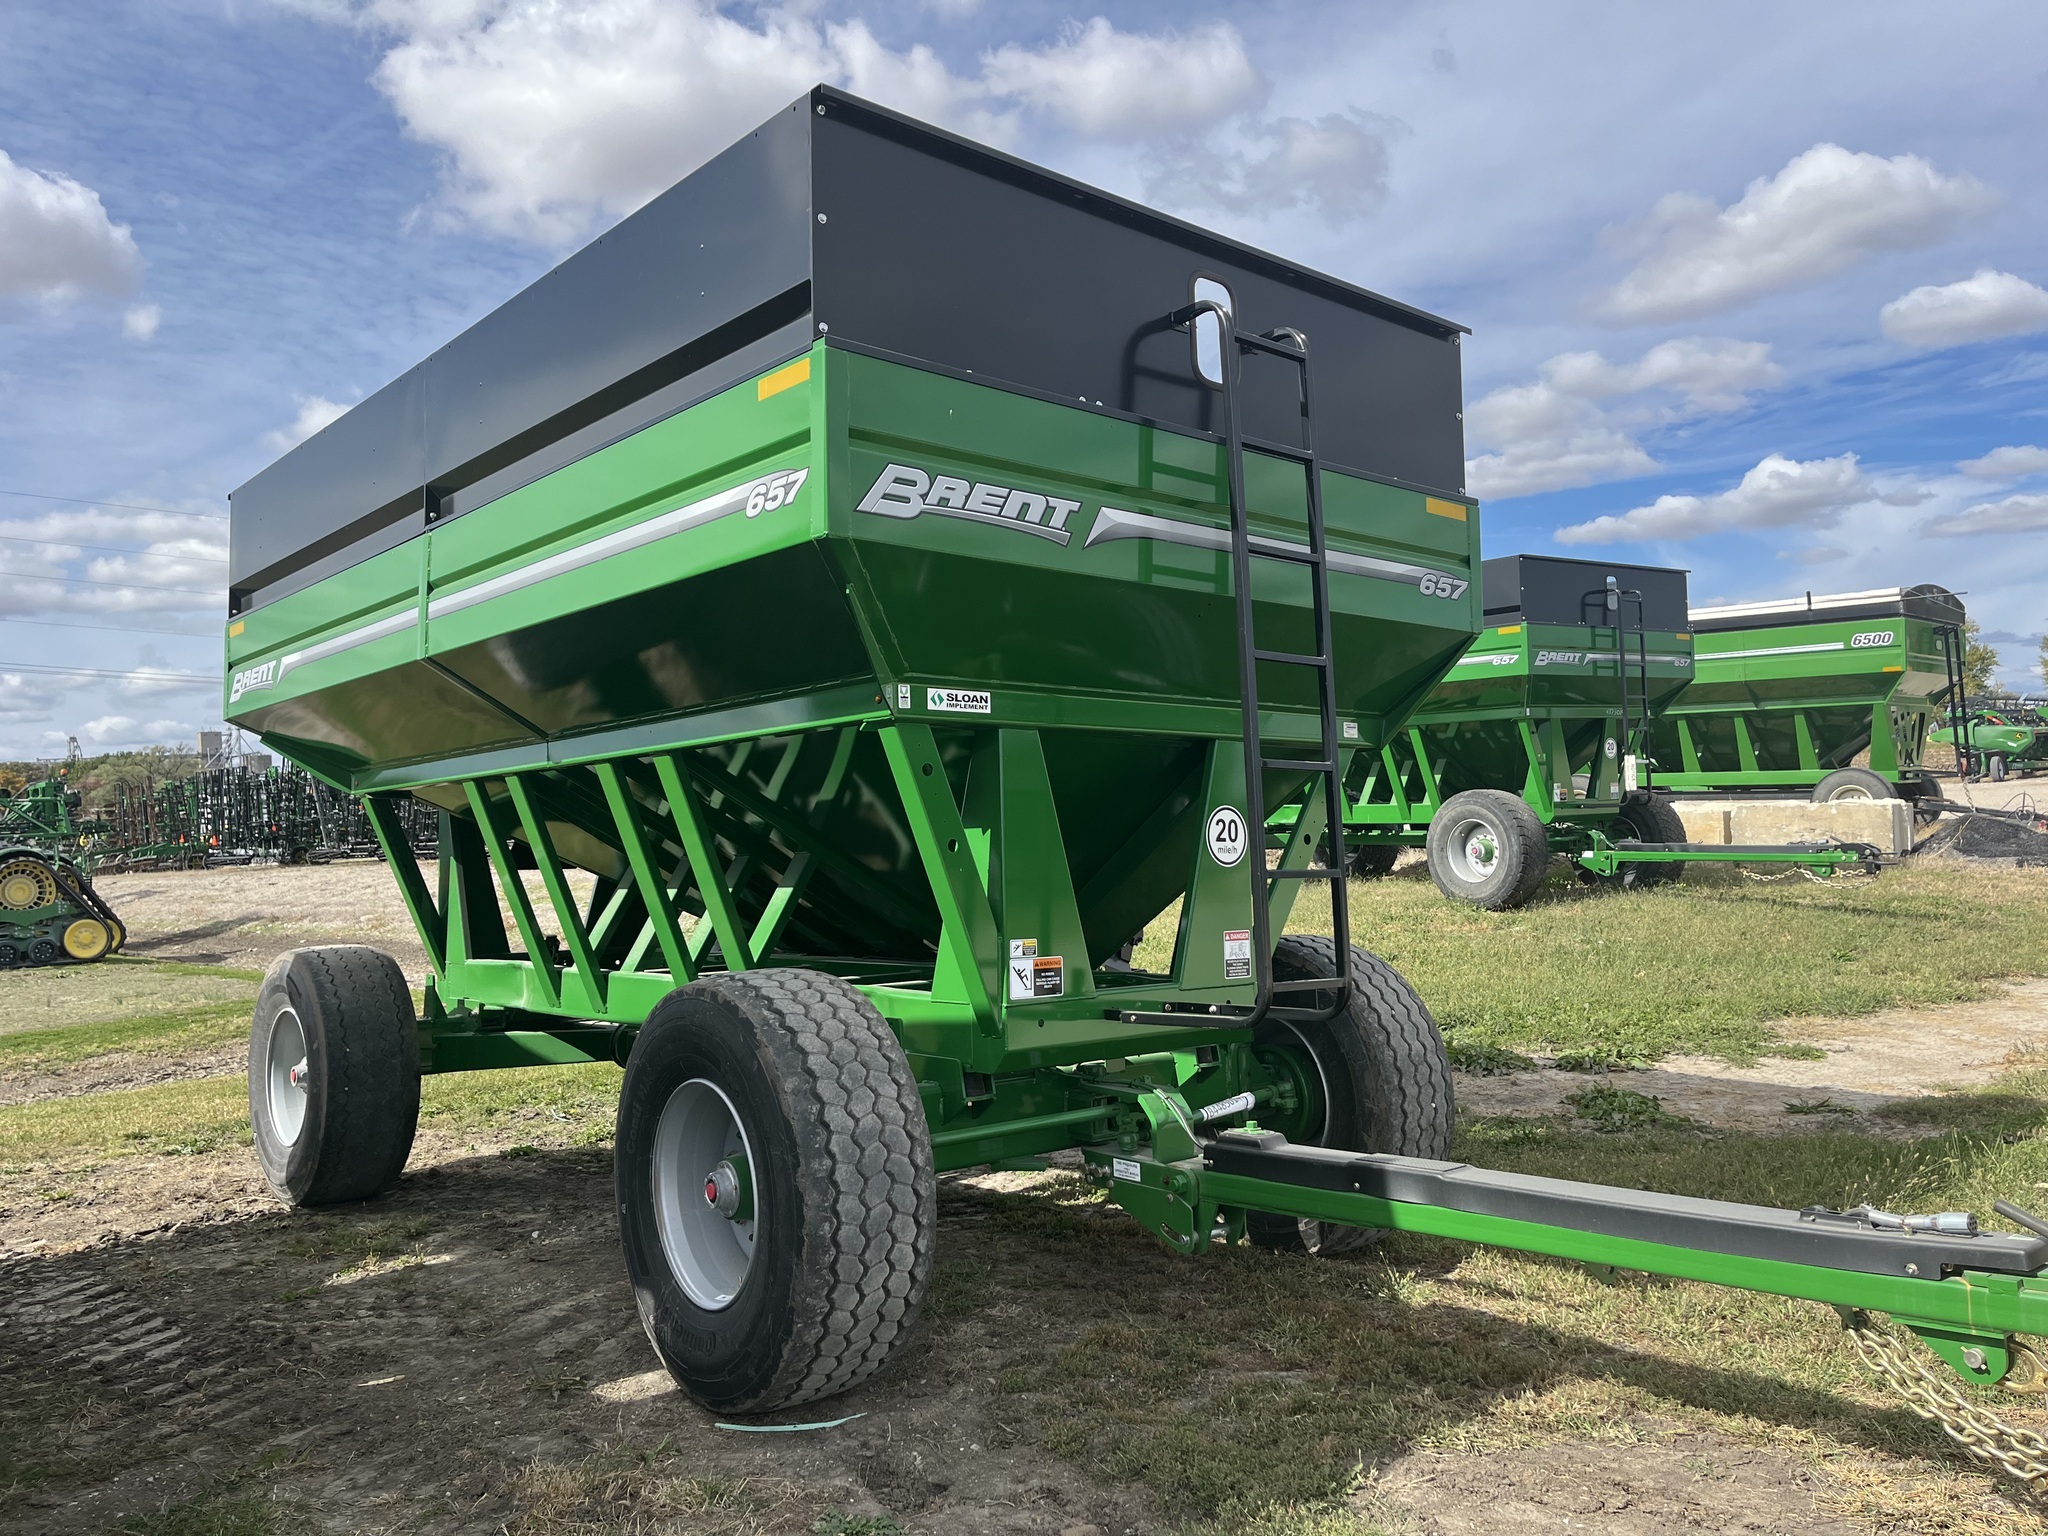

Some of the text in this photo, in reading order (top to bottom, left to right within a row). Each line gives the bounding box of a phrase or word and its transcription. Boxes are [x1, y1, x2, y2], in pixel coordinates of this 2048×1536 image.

[745, 465, 810, 519] 657
[1419, 573, 1469, 601] 657
[1851, 631, 1893, 648] 6500
[1492, 654, 1519, 666] 657
[1674, 658, 1690, 667] 657
[946, 692, 989, 704] SLOAN
[946, 702, 989, 711] IMPLEMENT
[1607, 742, 1615, 751] 20
[1215, 818, 1239, 843] 20
[1217, 845, 1238, 854] mile/h
